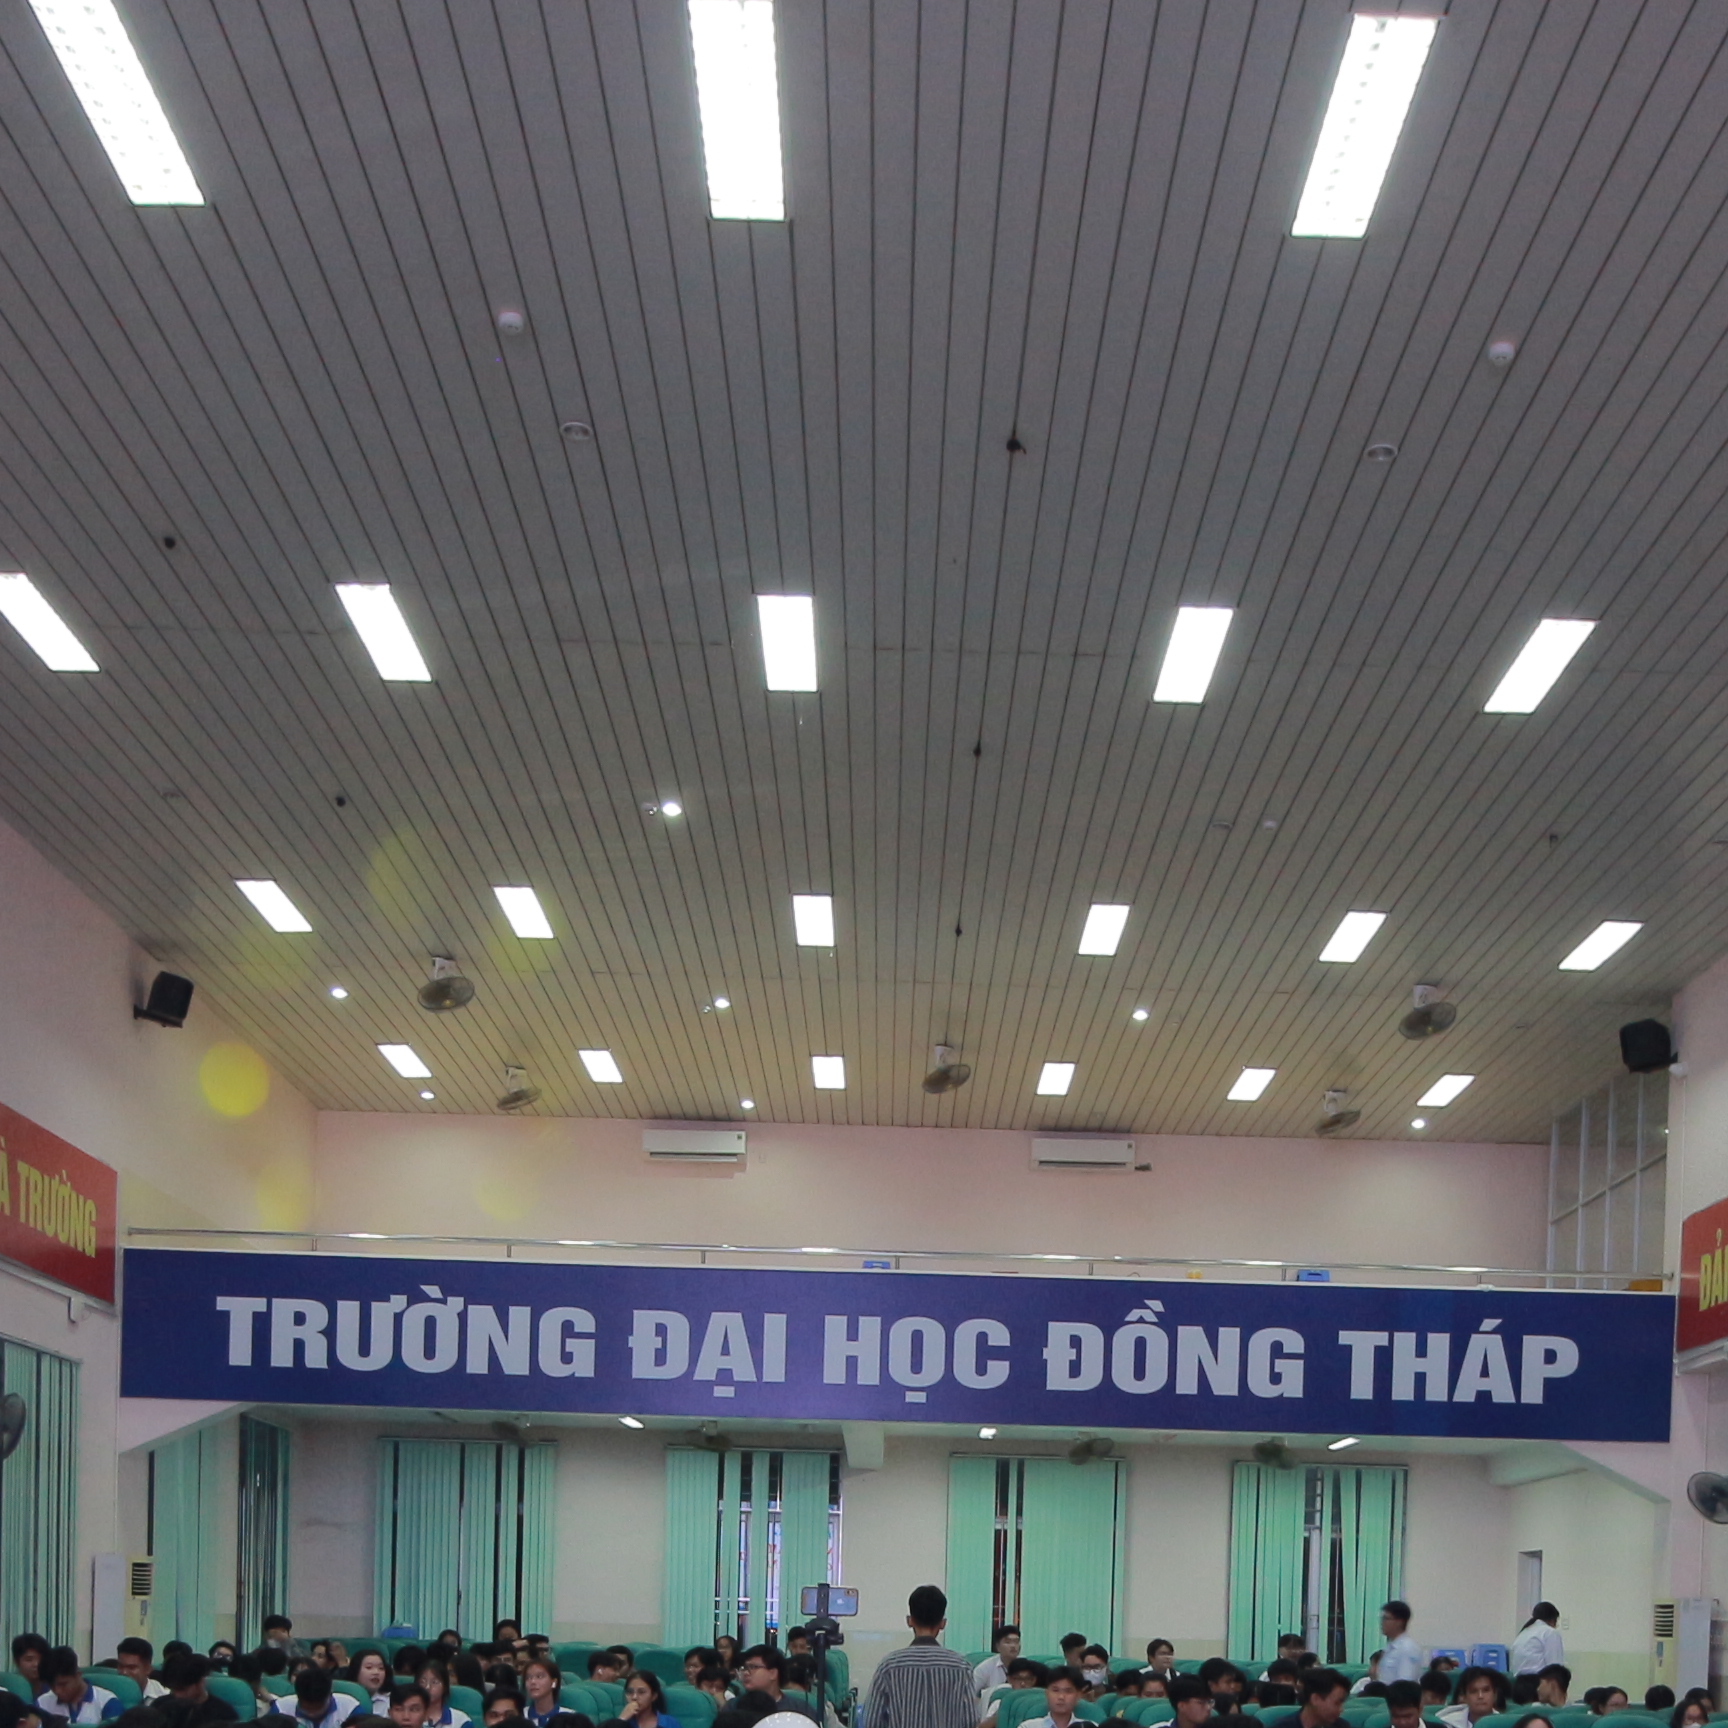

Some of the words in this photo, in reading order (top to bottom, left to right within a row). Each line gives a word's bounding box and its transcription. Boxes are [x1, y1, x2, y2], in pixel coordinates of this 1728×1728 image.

[16, 1159, 97, 1259] TRƯỜNG
[216, 1285, 596, 1378] TRƯỜNG
[629, 1309, 787, 1398] ĐẠI
[822, 1314, 1011, 1403] HỌC
[1042, 1299, 1305, 1398] ĐỒNG
[1338, 1318, 1579, 1404] THÁP
